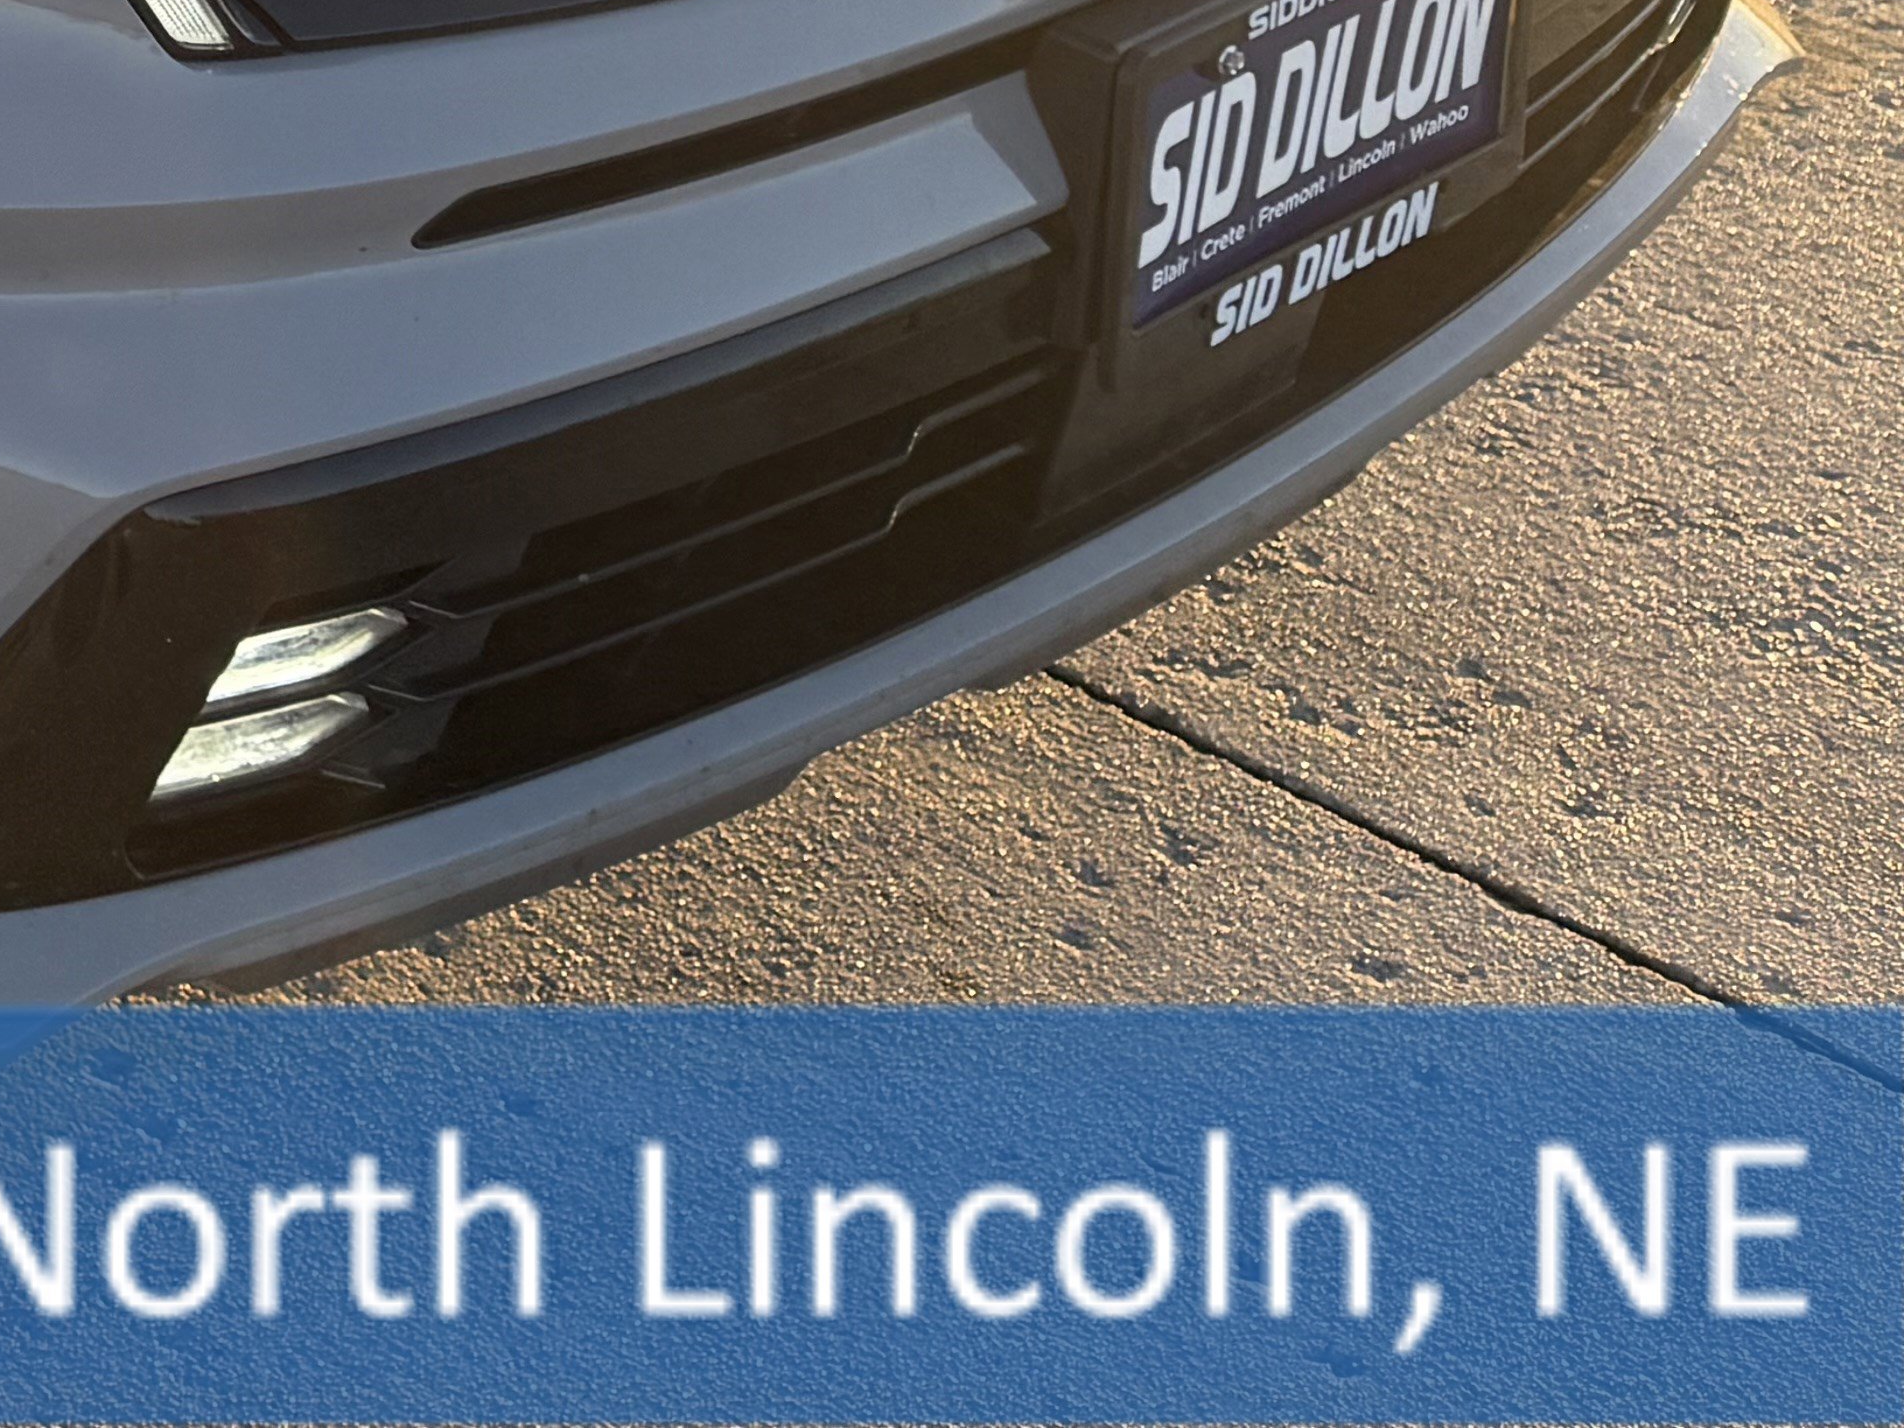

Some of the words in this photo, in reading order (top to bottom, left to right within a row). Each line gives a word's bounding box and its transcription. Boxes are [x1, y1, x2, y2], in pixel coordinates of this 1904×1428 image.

[1137, 72, 1257, 269] SID
[1151, 256, 1190, 293] Blair
[1200, 224, 1246, 262] Crete
[1257, 175, 1327, 229] Fremont
[1337, 138, 1397, 183] Lincoln
[1409, 104, 1470, 145] Wahoo
[1210, 263, 1284, 348] SID
[1287, 180, 1440, 306] DILLON
